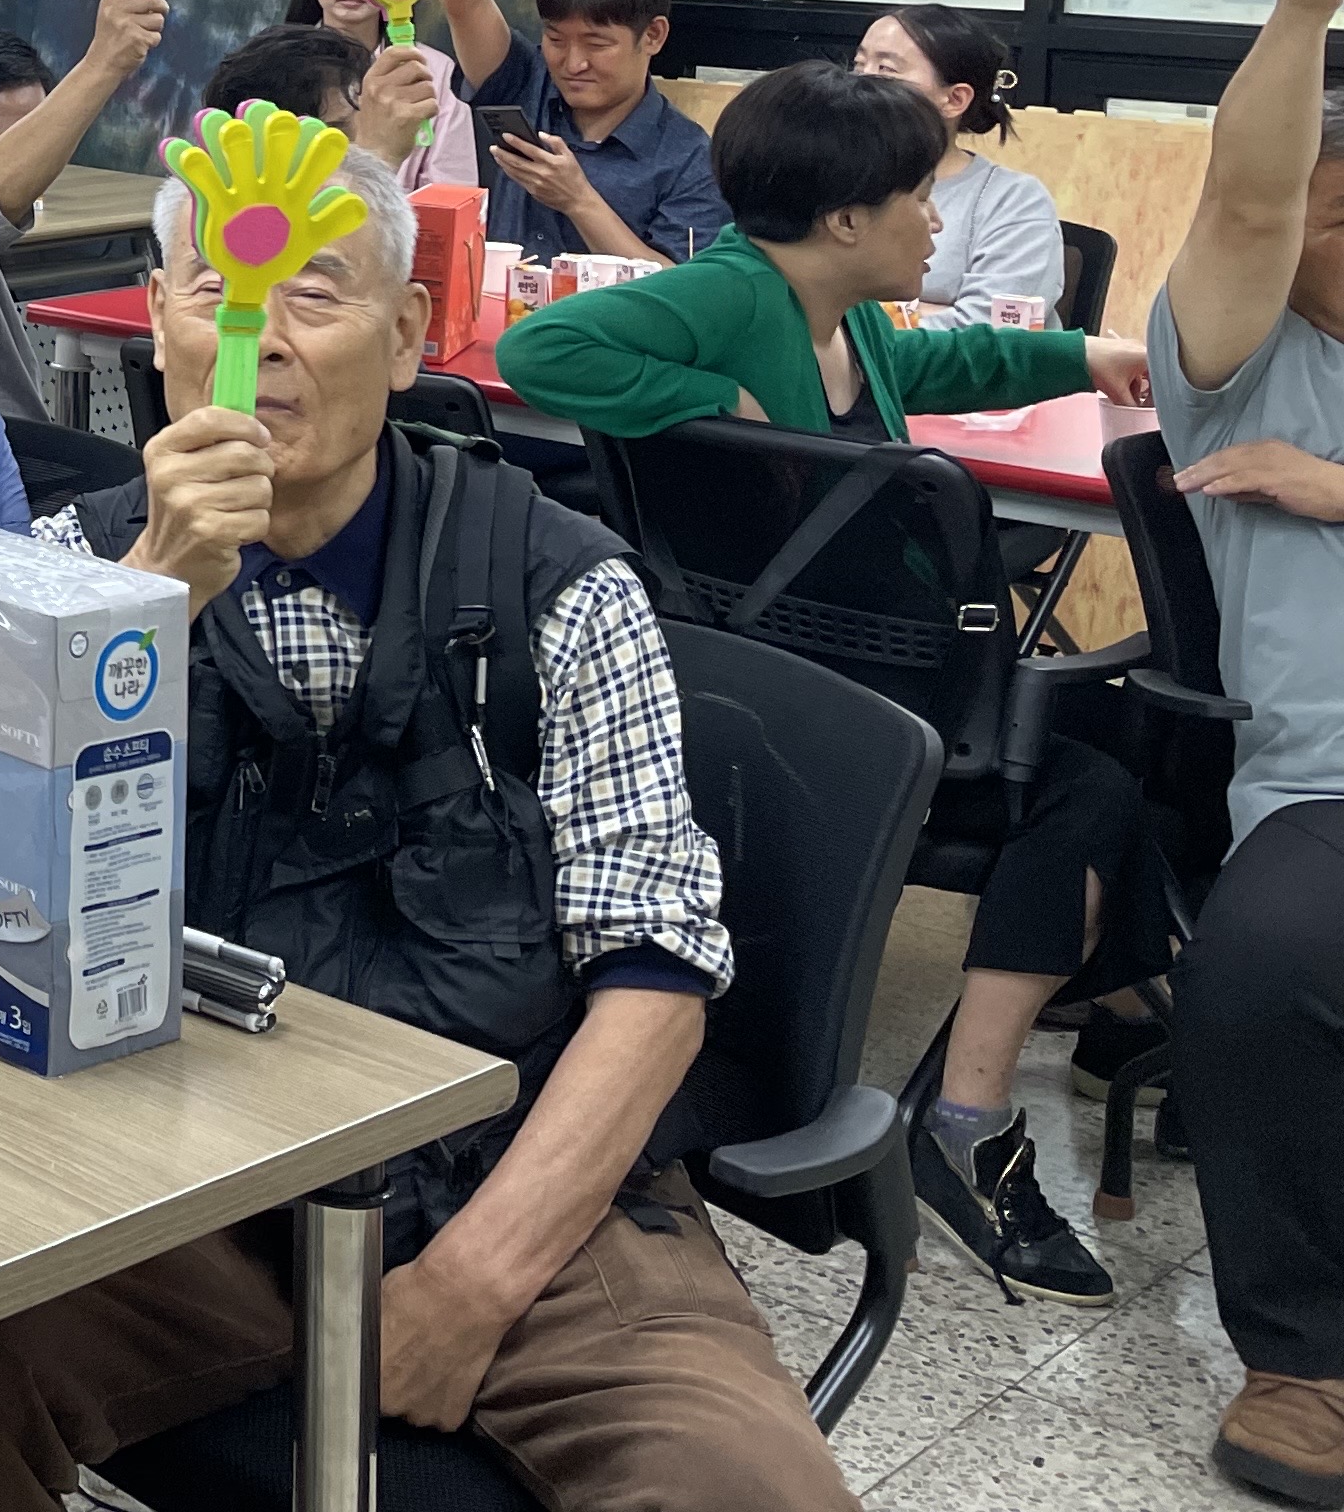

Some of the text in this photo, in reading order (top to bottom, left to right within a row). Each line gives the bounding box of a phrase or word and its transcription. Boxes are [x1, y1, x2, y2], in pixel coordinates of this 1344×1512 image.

[108, 656, 148, 679] 깨끗한
[114, 679, 140, 699] 나라
[0, 723, 40, 748] SOFTY
